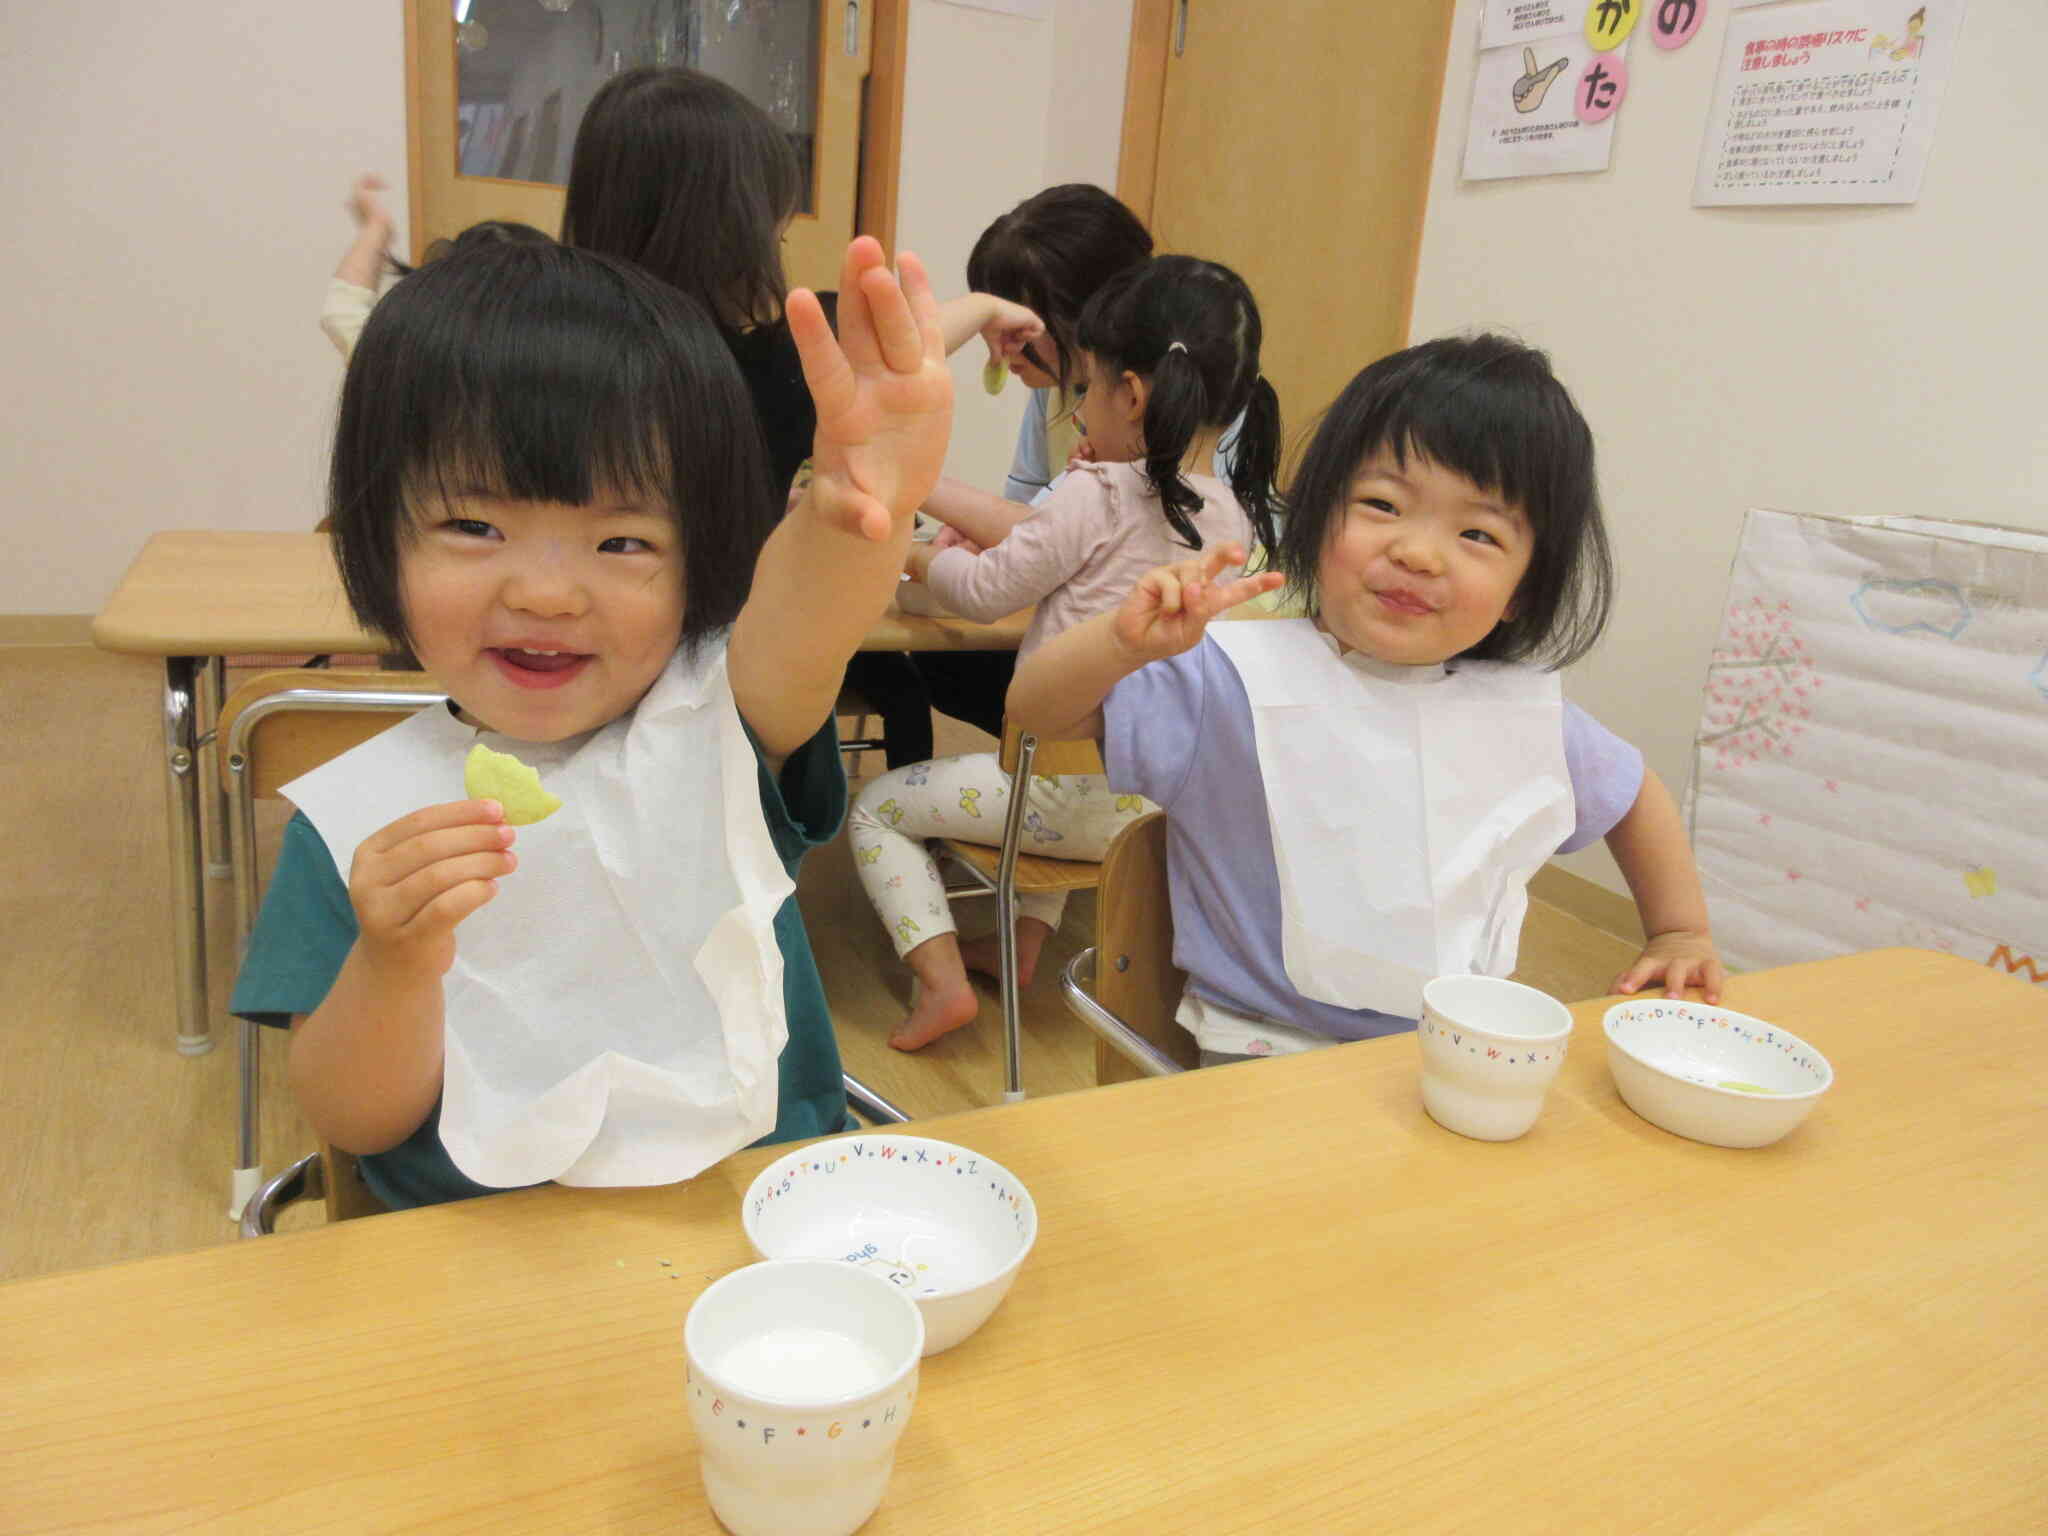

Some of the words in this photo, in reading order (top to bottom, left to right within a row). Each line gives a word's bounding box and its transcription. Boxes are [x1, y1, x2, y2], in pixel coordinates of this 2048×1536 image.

[1658, 0, 1697, 34] の
[1584, 63, 1617, 110] た
[1655, 1008, 1663, 1018] D
[1697, 1018, 1704, 1029] F
[1453, 1033, 1461, 1045] V
[1527, 1052, 1536, 1063] X
[782, 1179, 790, 1192] S
[825, 1160, 835, 1173] U
[854, 1143, 863, 1156] V
[881, 1144, 896, 1159] W
[916, 1149, 928, 1162] X
[968, 1160, 977, 1174] Z
[998, 1187, 1005, 1201] A
[763, 1428, 775, 1444] F
[828, 1422, 843, 1439] G
[884, 1405, 896, 1423] H
